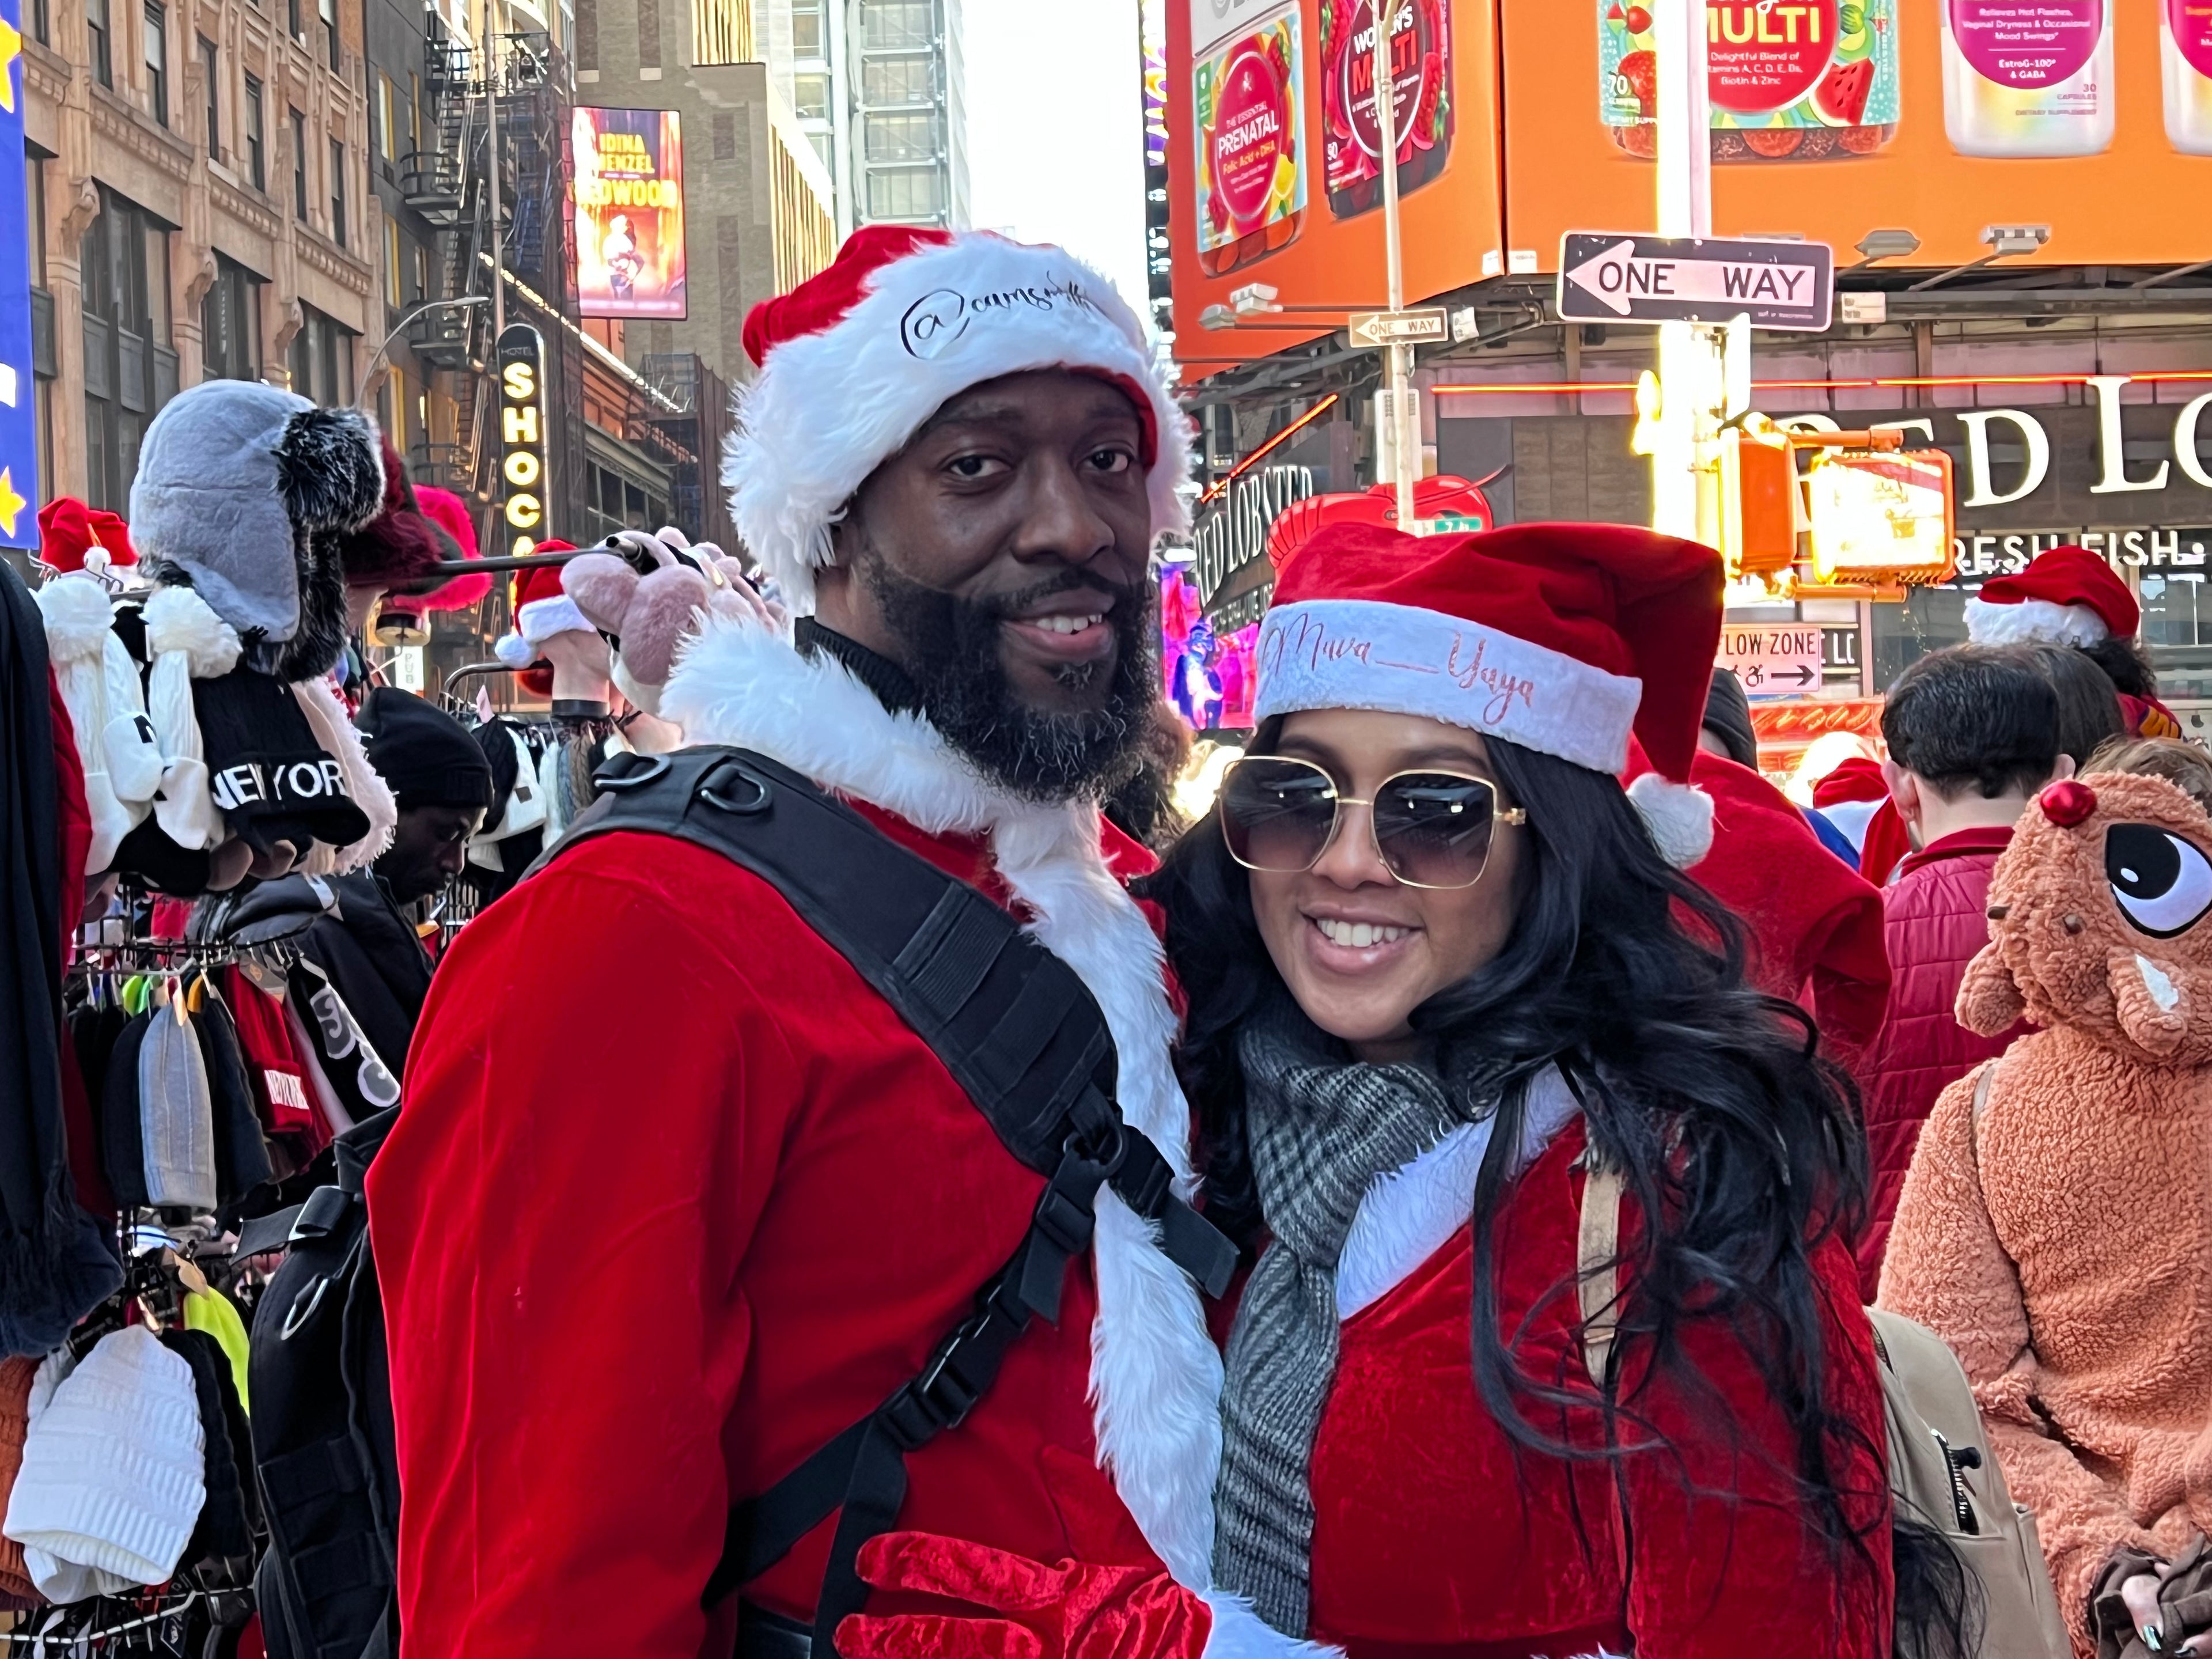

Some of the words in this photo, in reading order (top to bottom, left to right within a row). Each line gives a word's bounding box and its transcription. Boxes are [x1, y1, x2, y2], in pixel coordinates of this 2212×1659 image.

[1608, 74, 1628, 95] 70
[2083, 84, 2097, 92] 30
[1218, 110, 1279, 160] PRENATAL
[1599, 262, 1676, 295] ONE
[1722, 266, 1805, 301] WAY
[1369, 322, 1395, 336] ONE
[1407, 319, 1434, 332] WAY
[1720, 633, 1762, 656] LOW
[1770, 632, 1816, 655] ZONE
